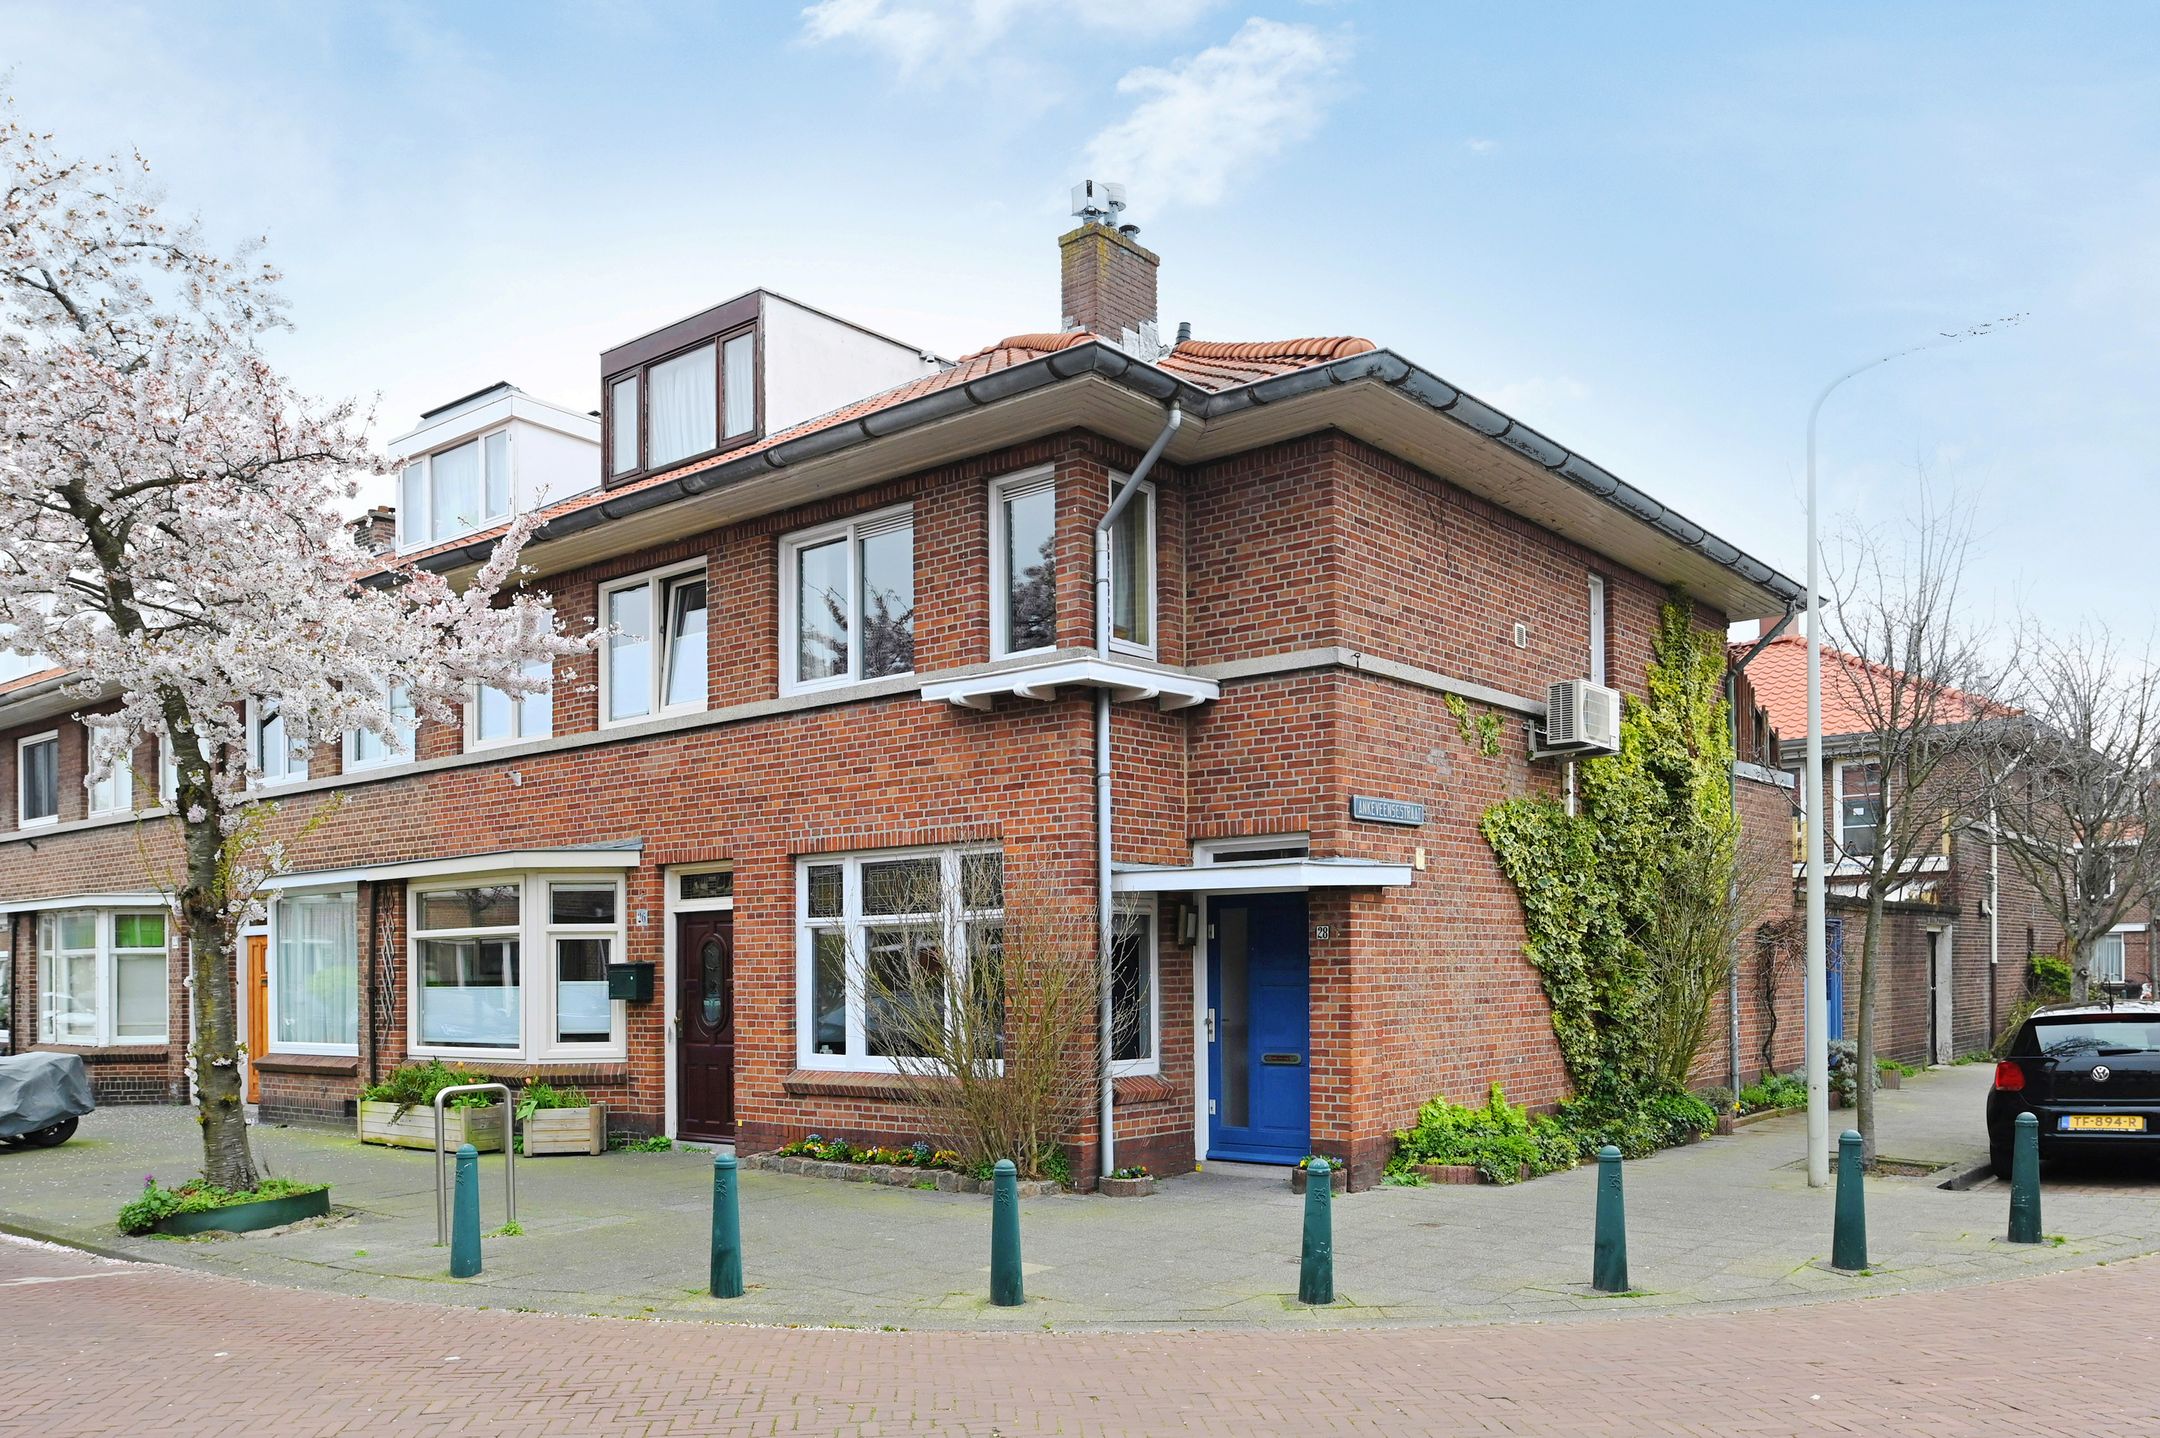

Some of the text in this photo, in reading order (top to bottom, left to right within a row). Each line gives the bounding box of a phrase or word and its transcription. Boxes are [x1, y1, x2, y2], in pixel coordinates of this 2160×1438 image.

[1358, 799, 1422, 821] ANKEVEENSESTRAAT
[1317, 926, 1328, 939] 28
[2073, 1116, 2137, 1127] TF-894-R
